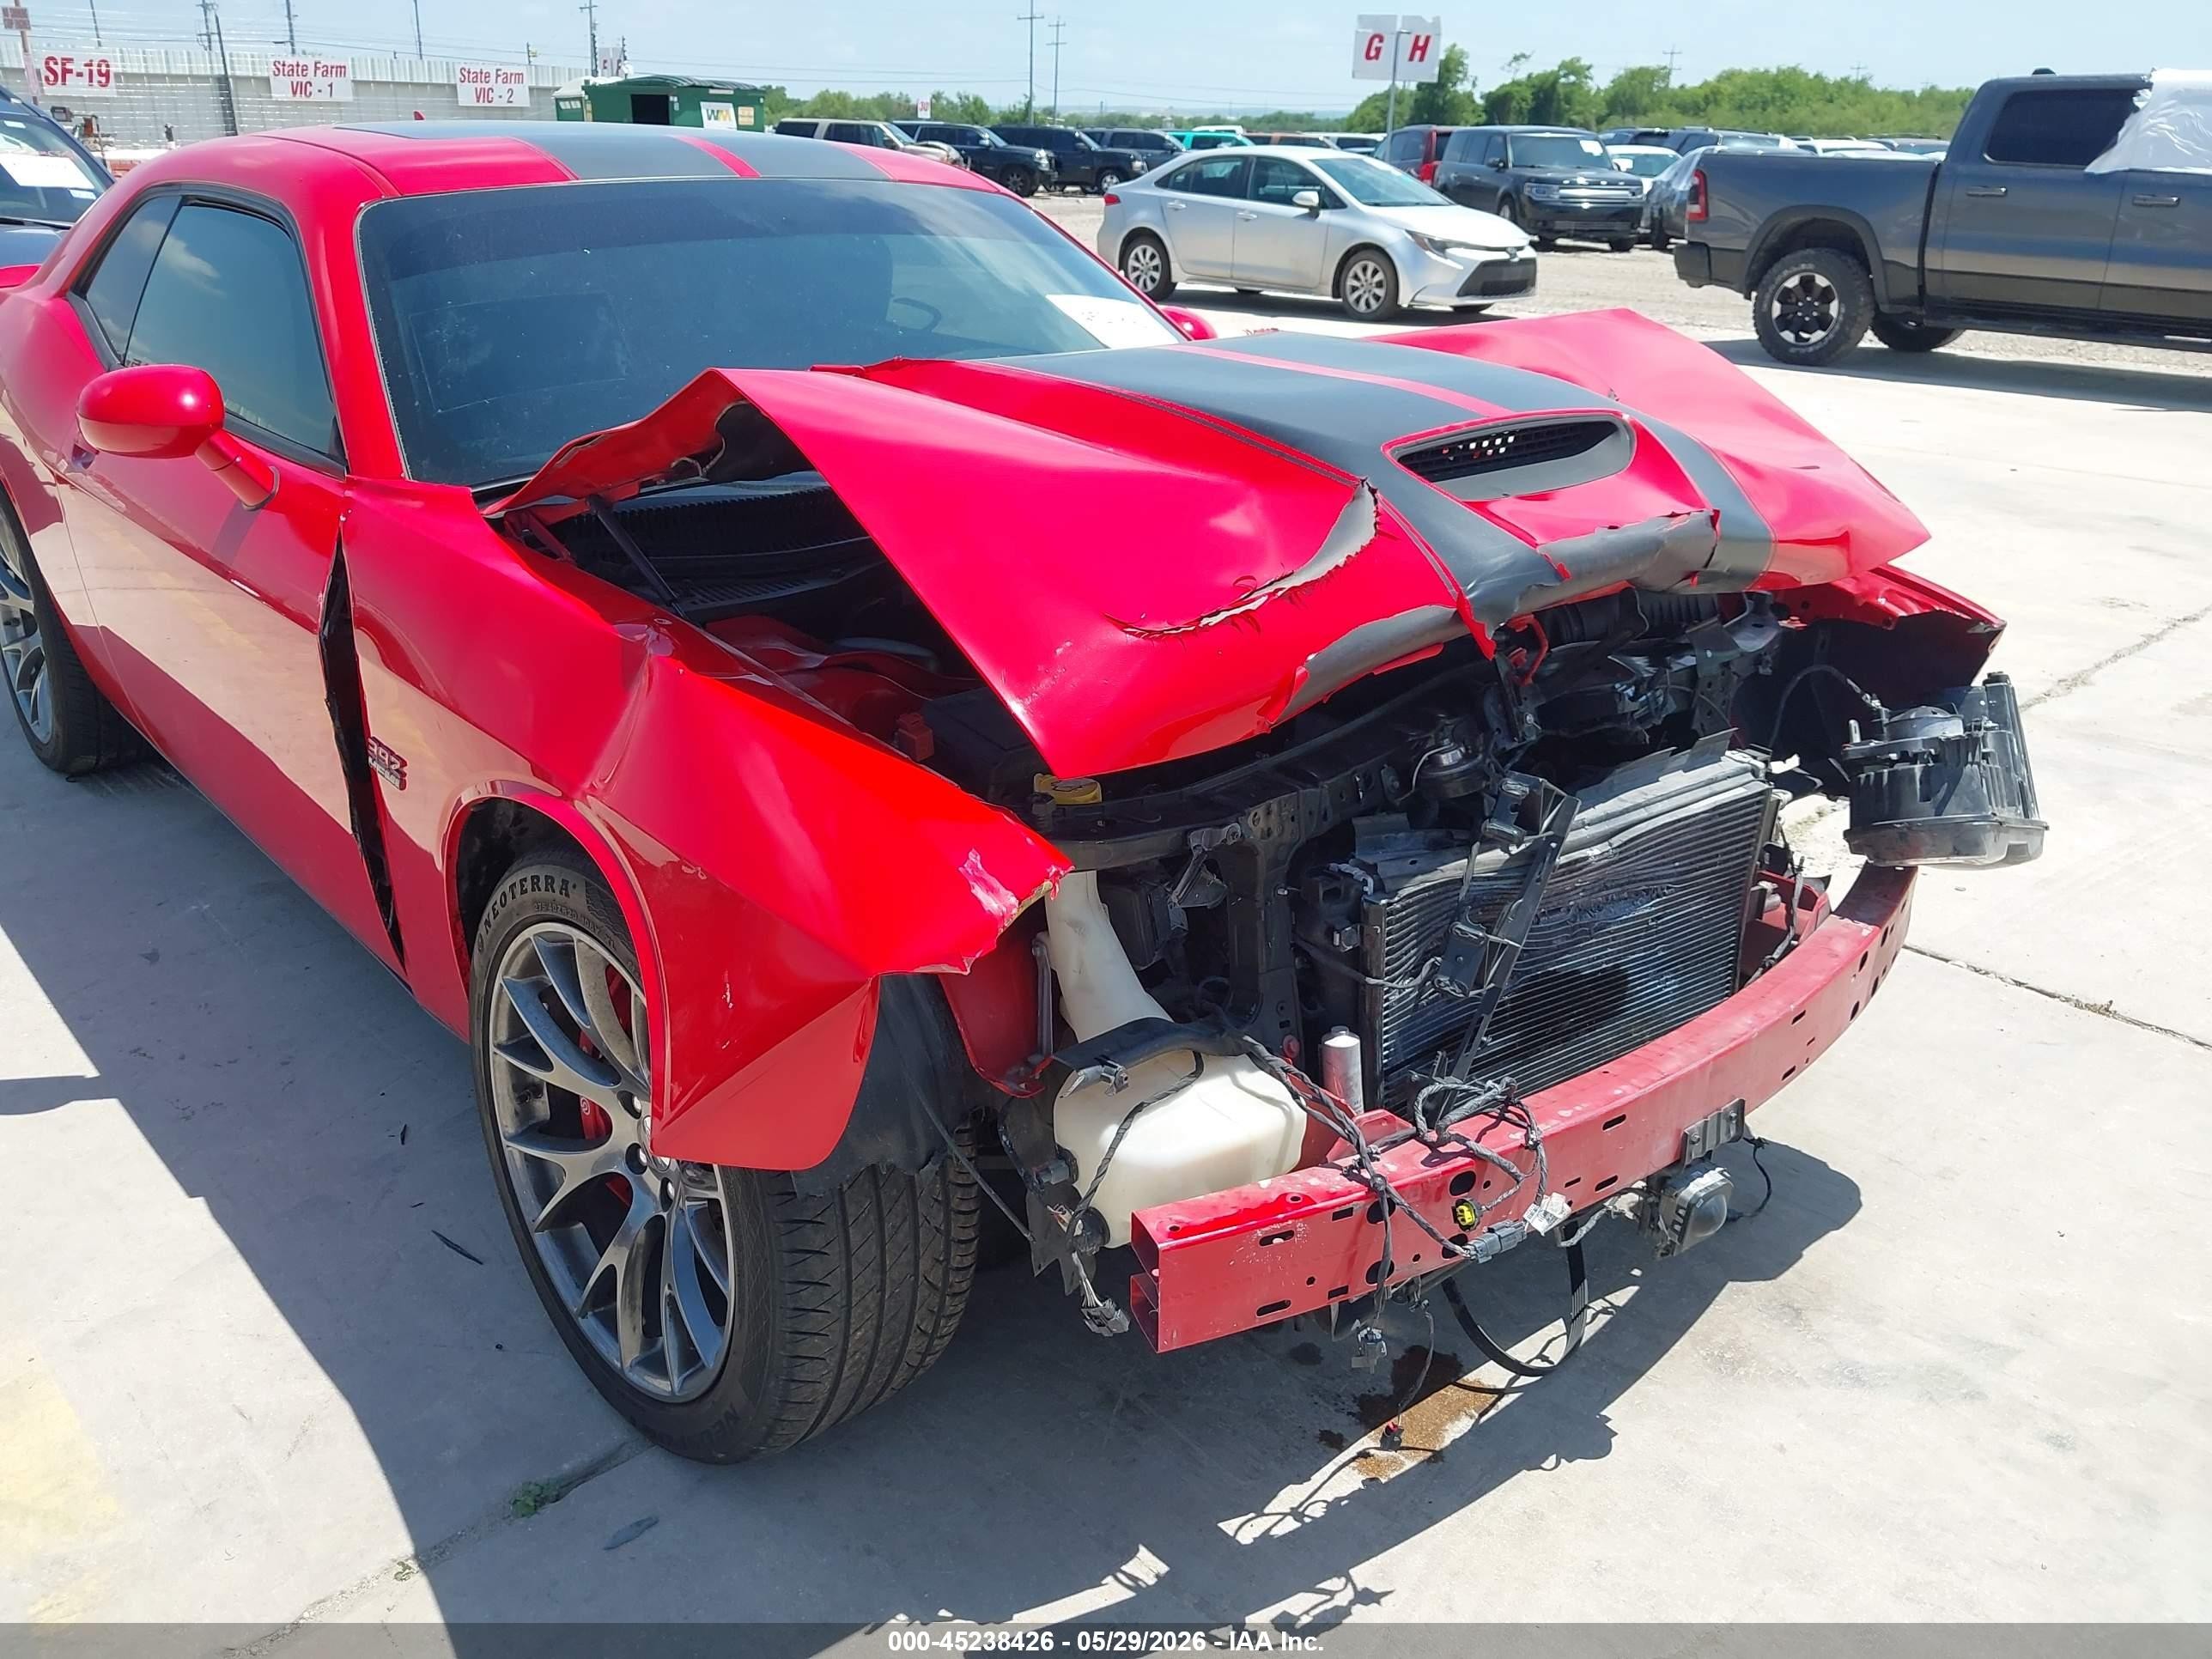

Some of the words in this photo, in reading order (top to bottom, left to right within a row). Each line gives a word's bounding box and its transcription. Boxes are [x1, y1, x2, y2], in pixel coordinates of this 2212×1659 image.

[1365, 33, 1384, 61] G
[1408, 35, 1431, 62] H
[44, 56, 111, 88] SF-19
[273, 60, 309, 77] State
[313, 60, 346, 78] Farm
[459, 67, 491, 83] State
[495, 69, 524, 84] Farm
[290, 81, 313, 98] VIC
[327, 82, 333, 98] 1
[475, 88, 494, 103] VIC
[507, 88, 514, 103] 2
[706, 109, 731, 121] WM
[368, 737, 401, 771] 392
[483, 874, 571, 934] NEOTERRA
